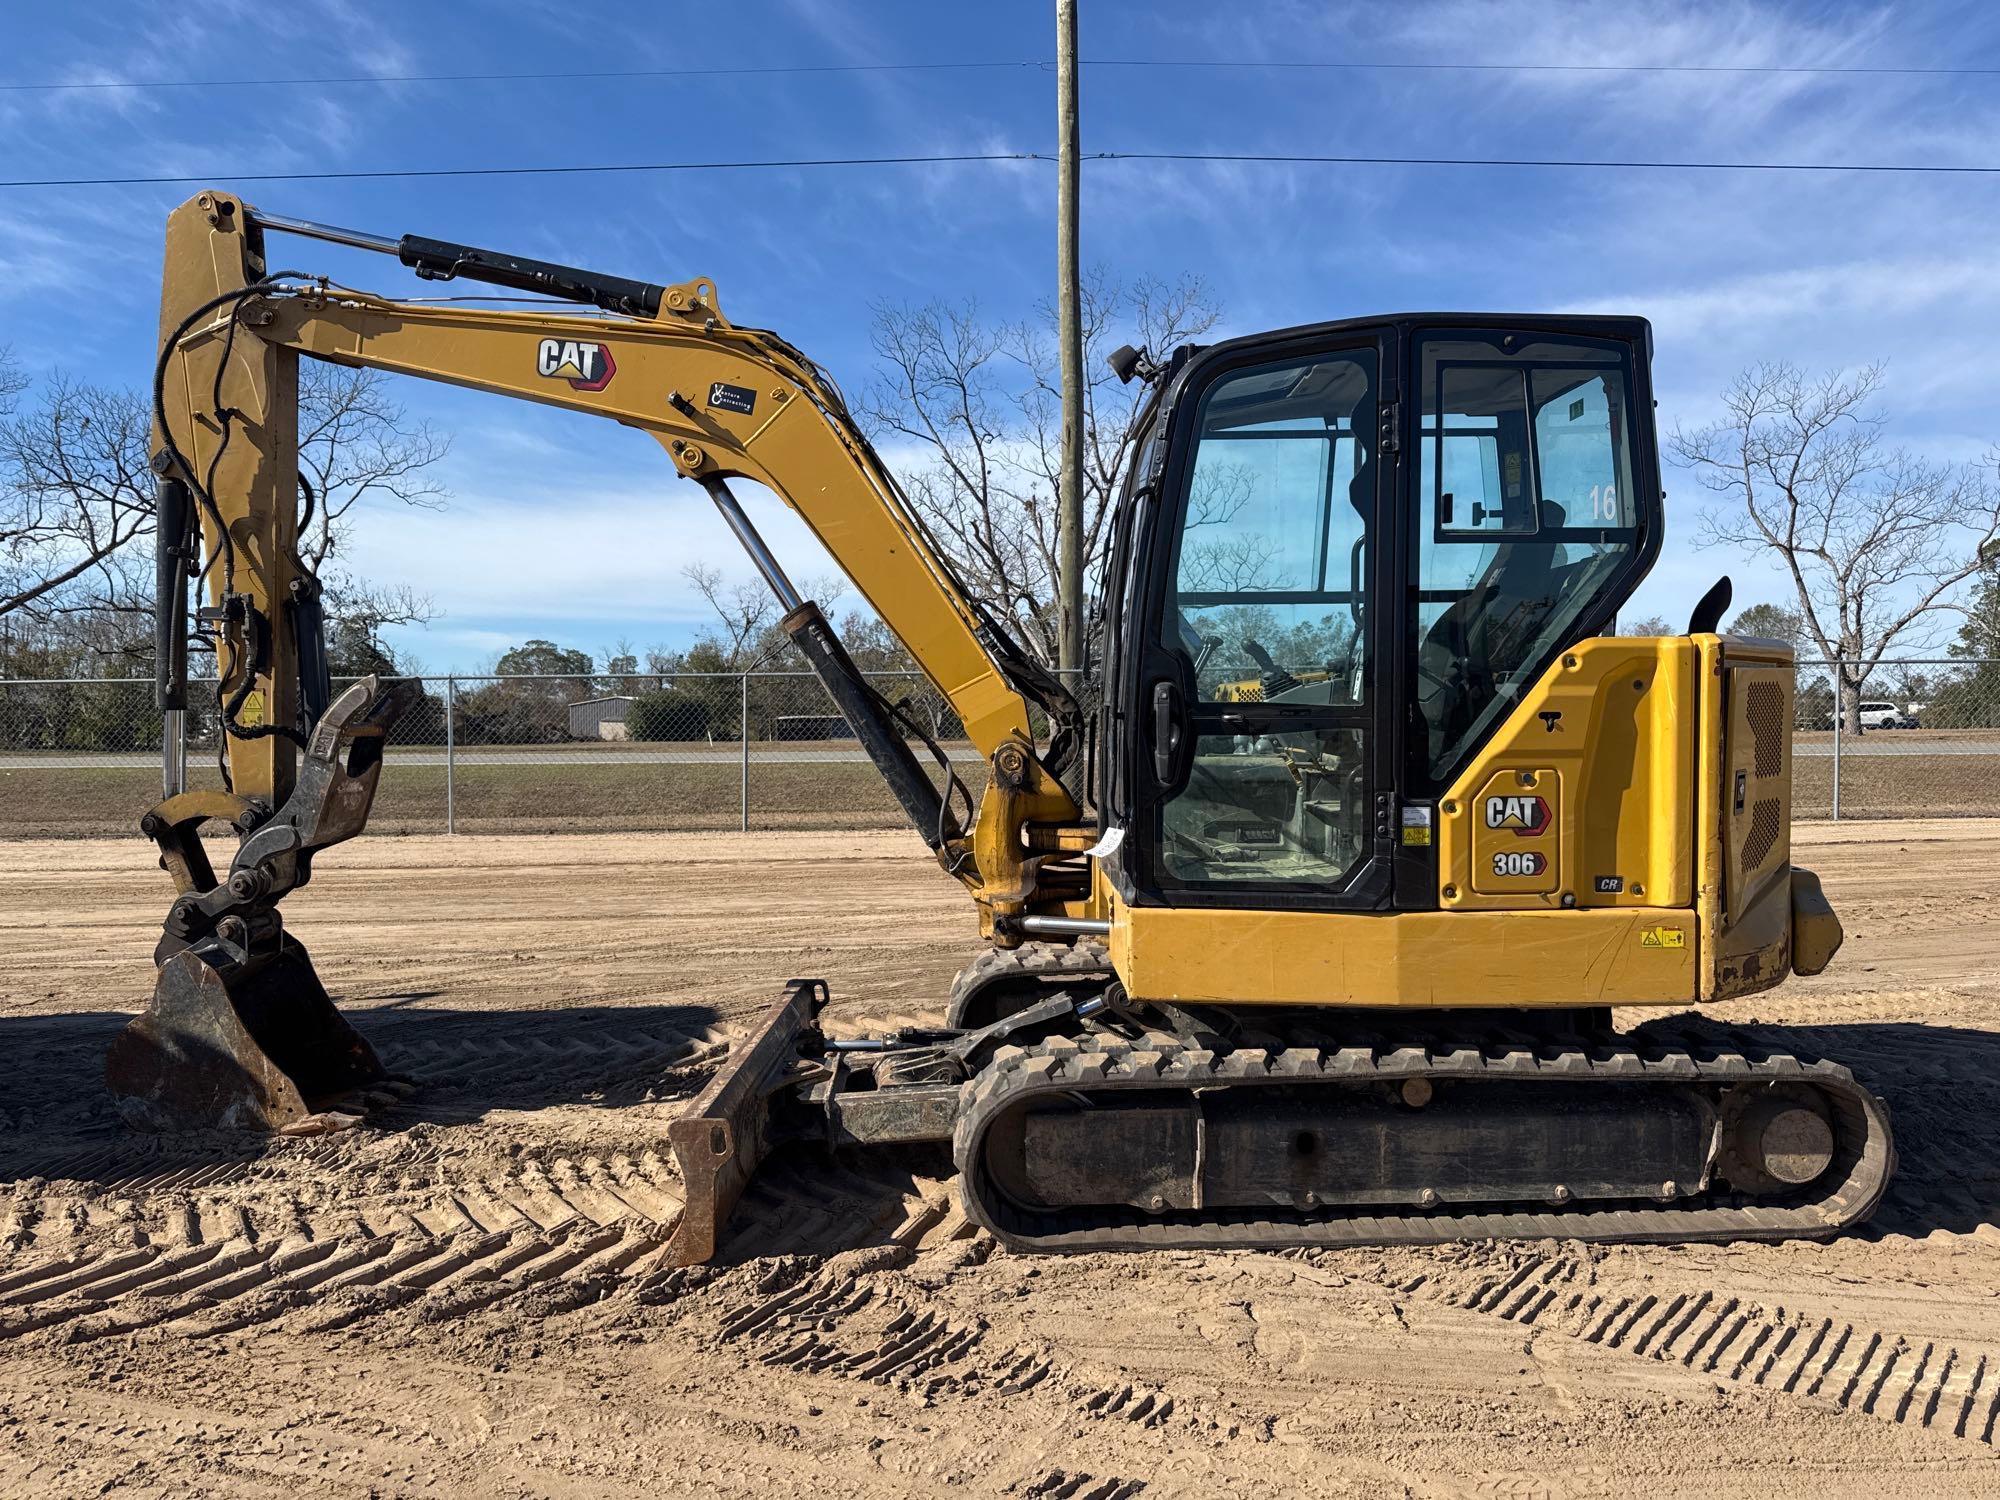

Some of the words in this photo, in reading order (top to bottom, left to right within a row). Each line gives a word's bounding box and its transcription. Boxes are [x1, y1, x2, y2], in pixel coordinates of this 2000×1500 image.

[539, 339, 598, 380] CAT
[1589, 484, 1617, 521] 16
[1487, 797, 1536, 828] CAT
[1494, 853, 1535, 876] 306
[1601, 878, 1618, 891] CR
